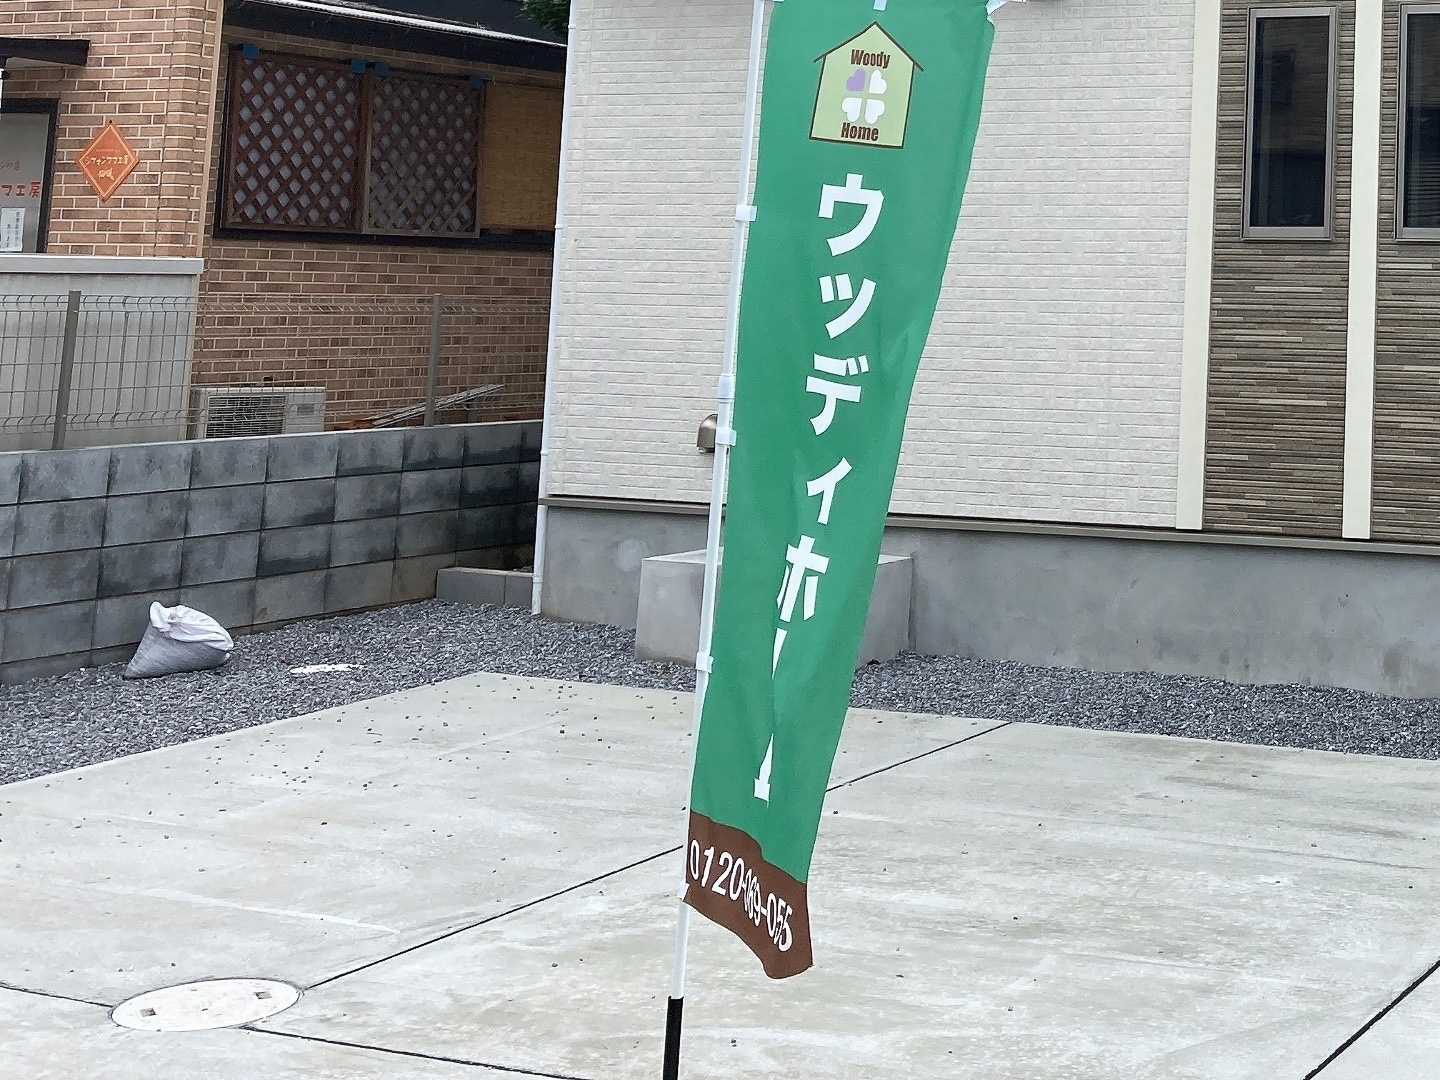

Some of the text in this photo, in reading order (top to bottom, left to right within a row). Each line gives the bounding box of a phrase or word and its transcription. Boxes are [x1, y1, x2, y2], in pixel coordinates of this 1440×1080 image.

[850, 49, 891, 69] Woody
[840, 122, 879, 141] Home
[753, 173, 885, 809] ウッディホー
